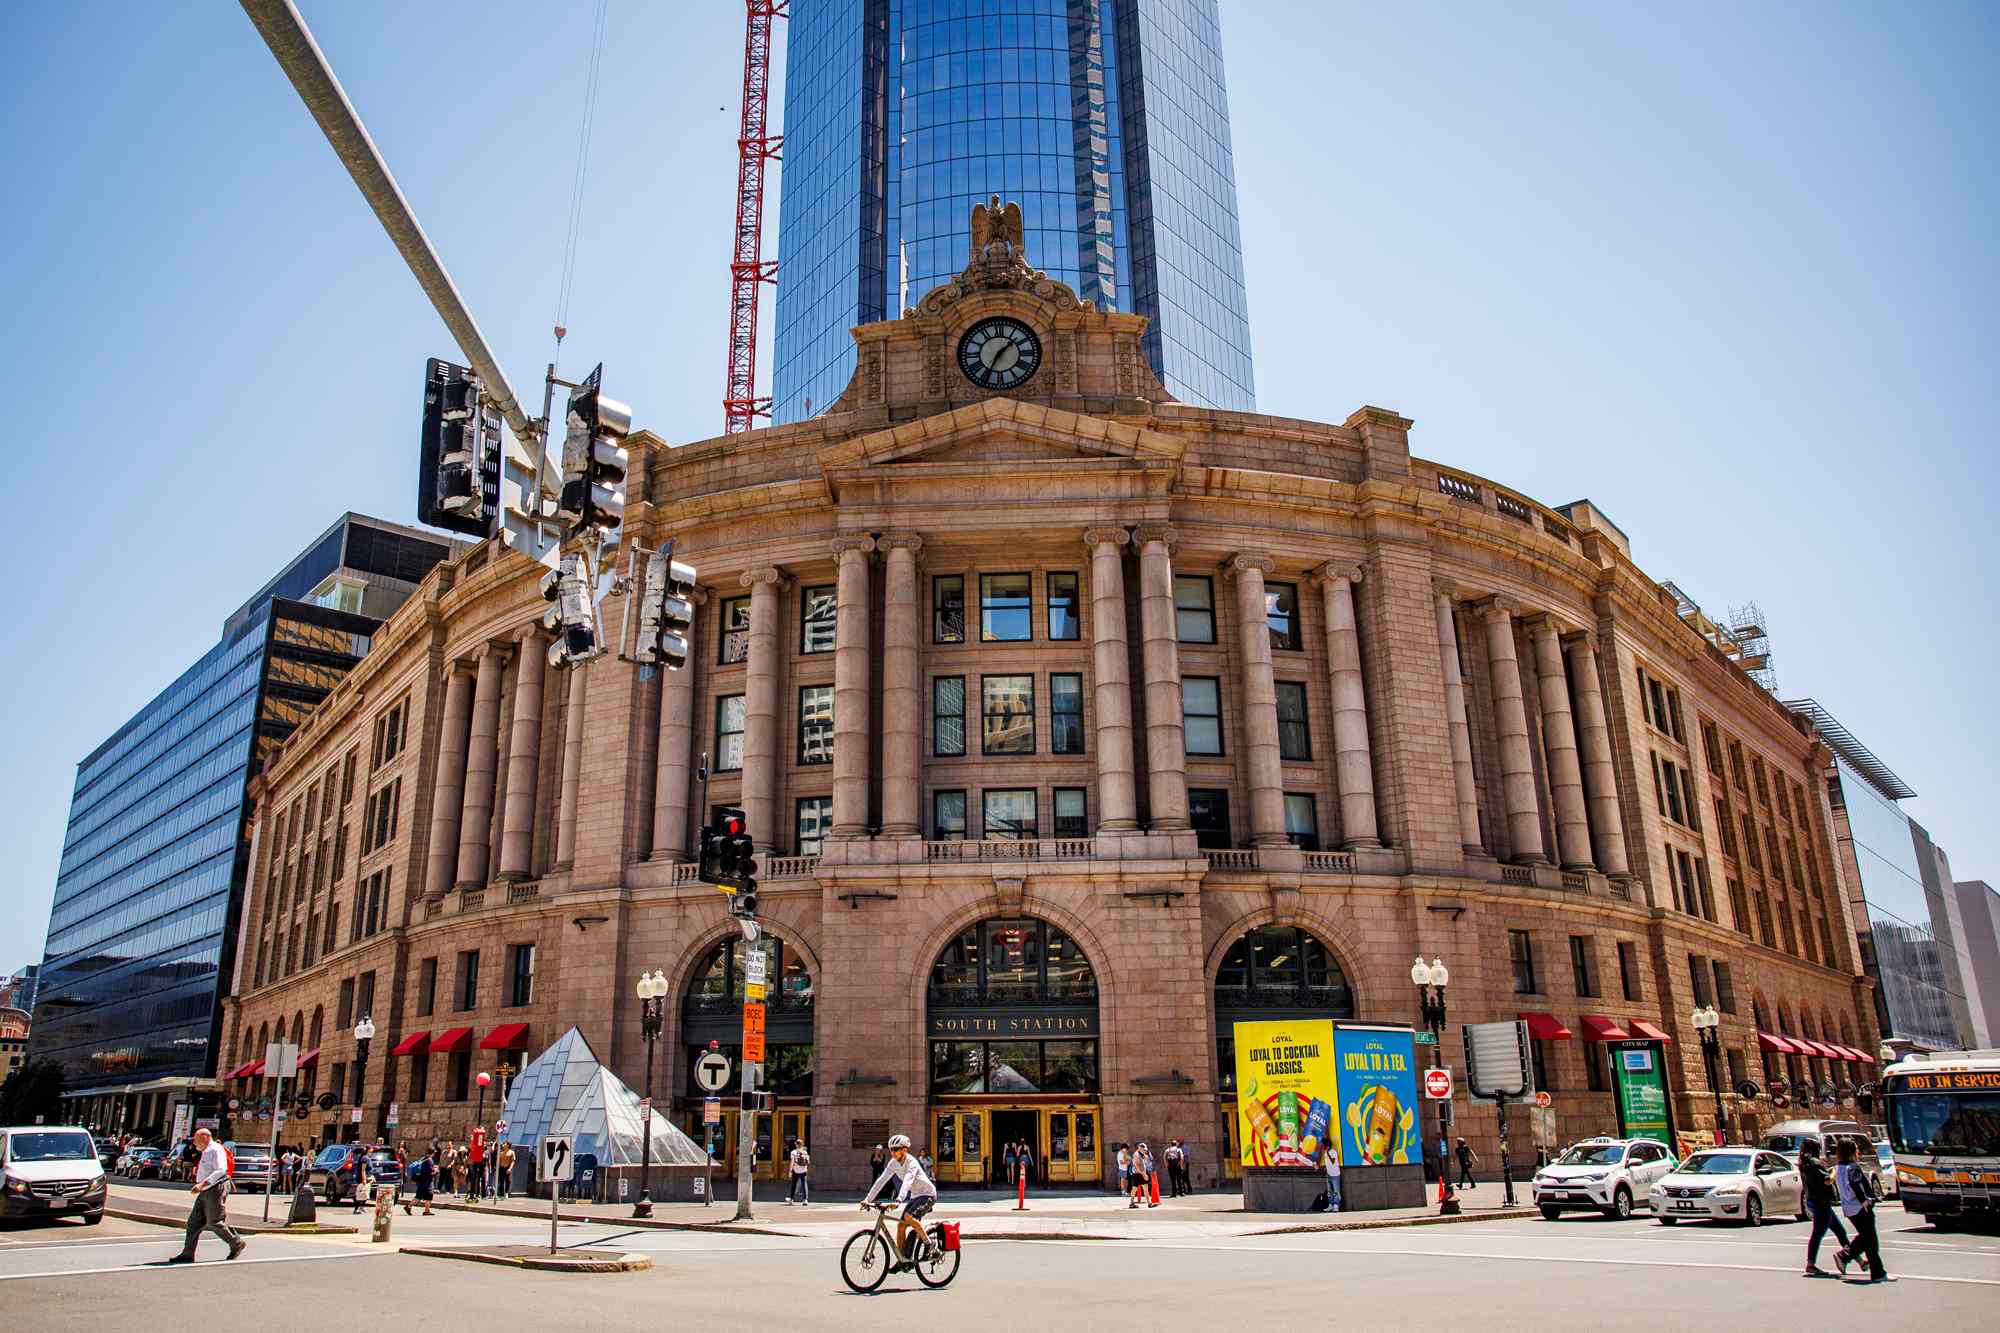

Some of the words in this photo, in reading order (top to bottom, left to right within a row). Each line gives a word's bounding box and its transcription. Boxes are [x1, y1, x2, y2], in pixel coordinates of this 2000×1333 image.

[935, 1019, 998, 1031] SOUTH
[1009, 1017, 1089, 1030] STATION
[1271, 1035, 1293, 1043] LOYAL
[1365, 1042, 1384, 1050] LOYAL
[1249, 1047, 1271, 1062] LOYAL
[1272, 1047, 1282, 1060] TO
[1283, 1044, 1320, 1060] COCKTAIL
[1265, 1060, 1305, 1076] CLASSICS.
[1344, 1052, 1369, 1071] LOYAL
[1370, 1053, 1381, 1072] TO
[1383, 1054, 1389, 1071] A
[1390, 1053, 1408, 1072] TEA.
[703, 1062, 726, 1085] T
[1908, 1075, 1931, 1088] NOT
[1936, 1075, 1952, 1088] IN
[1309, 1111, 1327, 1127] LOYAL
[1375, 1104, 1393, 1122] LOYAL
